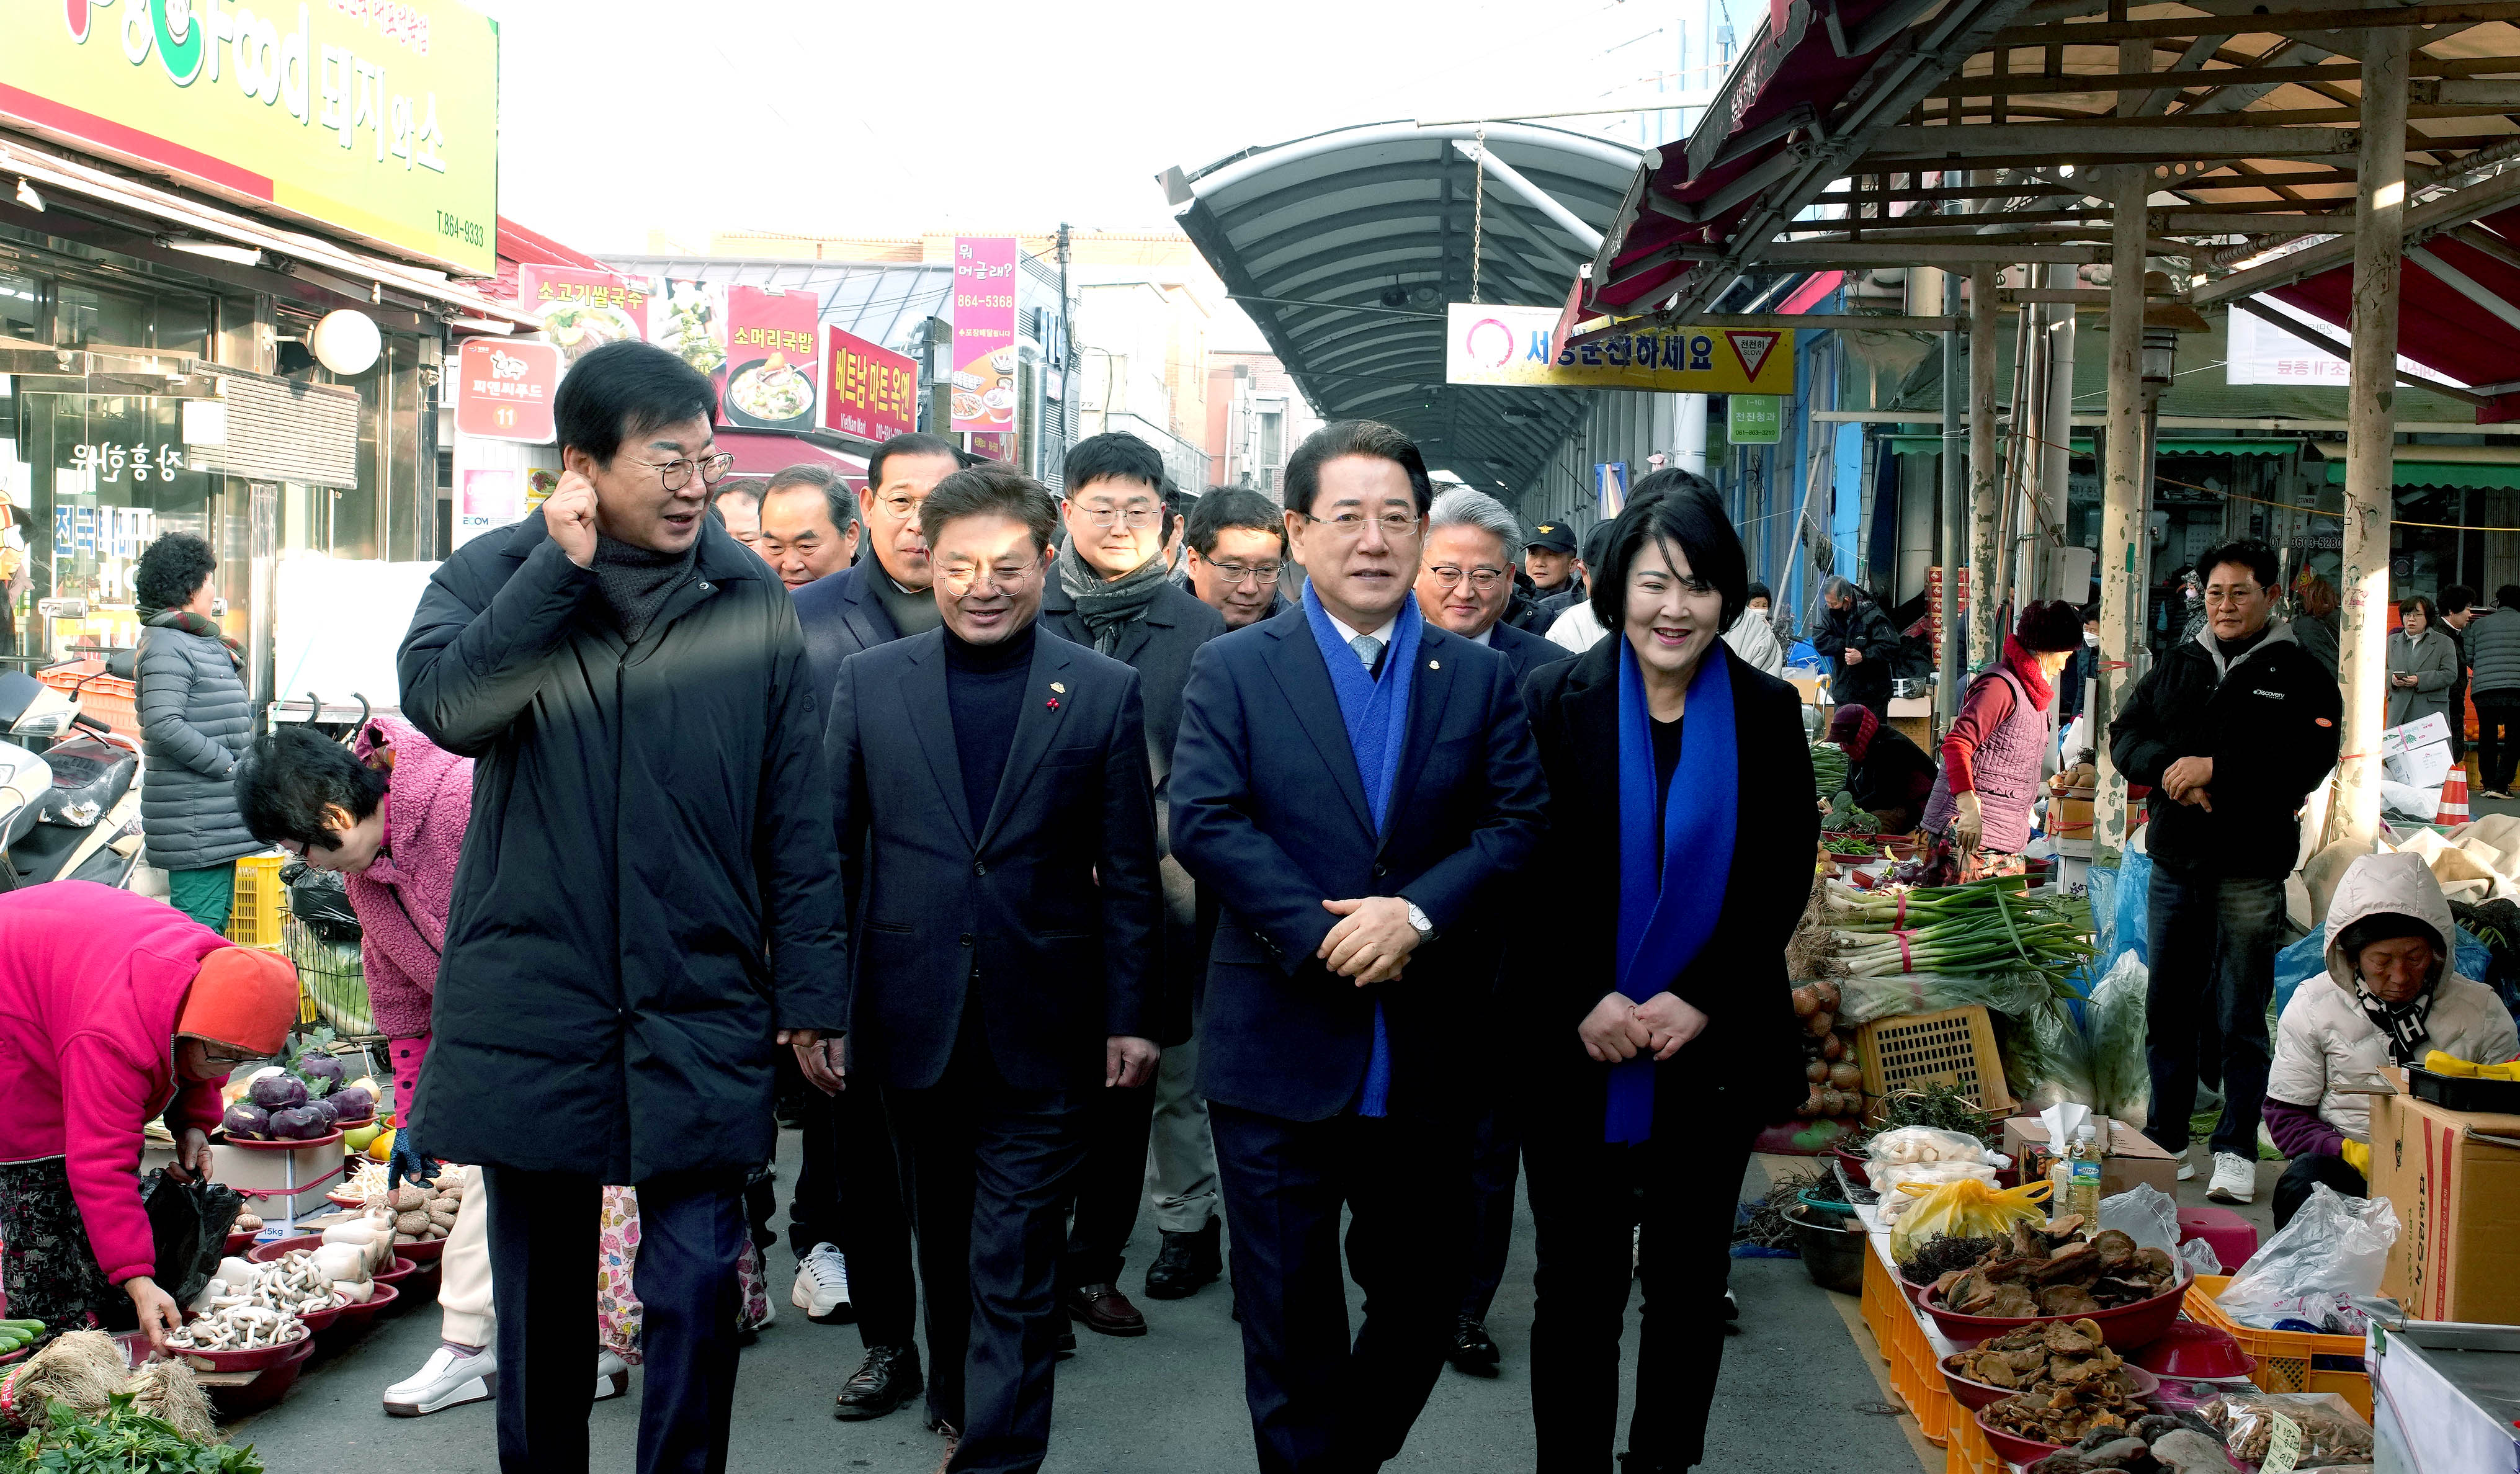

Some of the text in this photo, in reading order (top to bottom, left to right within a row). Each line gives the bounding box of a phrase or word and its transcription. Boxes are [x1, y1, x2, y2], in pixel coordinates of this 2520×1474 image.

[437, 210, 483, 248] T.864-9333
[958, 243, 973, 260] 뭐
[537, 280, 643, 310] 소고기쌀국수
[957, 294, 1013, 308] 864-5368
[733, 326, 814, 354] 소머리국밥
[1741, 339, 1764, 350] 천천히
[472, 380, 543, 398] 피엔씨푸드
[835, 346, 868, 410] 베트남
[869, 359, 889, 414] 마트
[497, 408, 514, 426] 11
[841, 413, 866, 435] VietNam Mart
[2256, 689, 2285, 700] Discovery
[264, 1228, 284, 1236] 15kg
